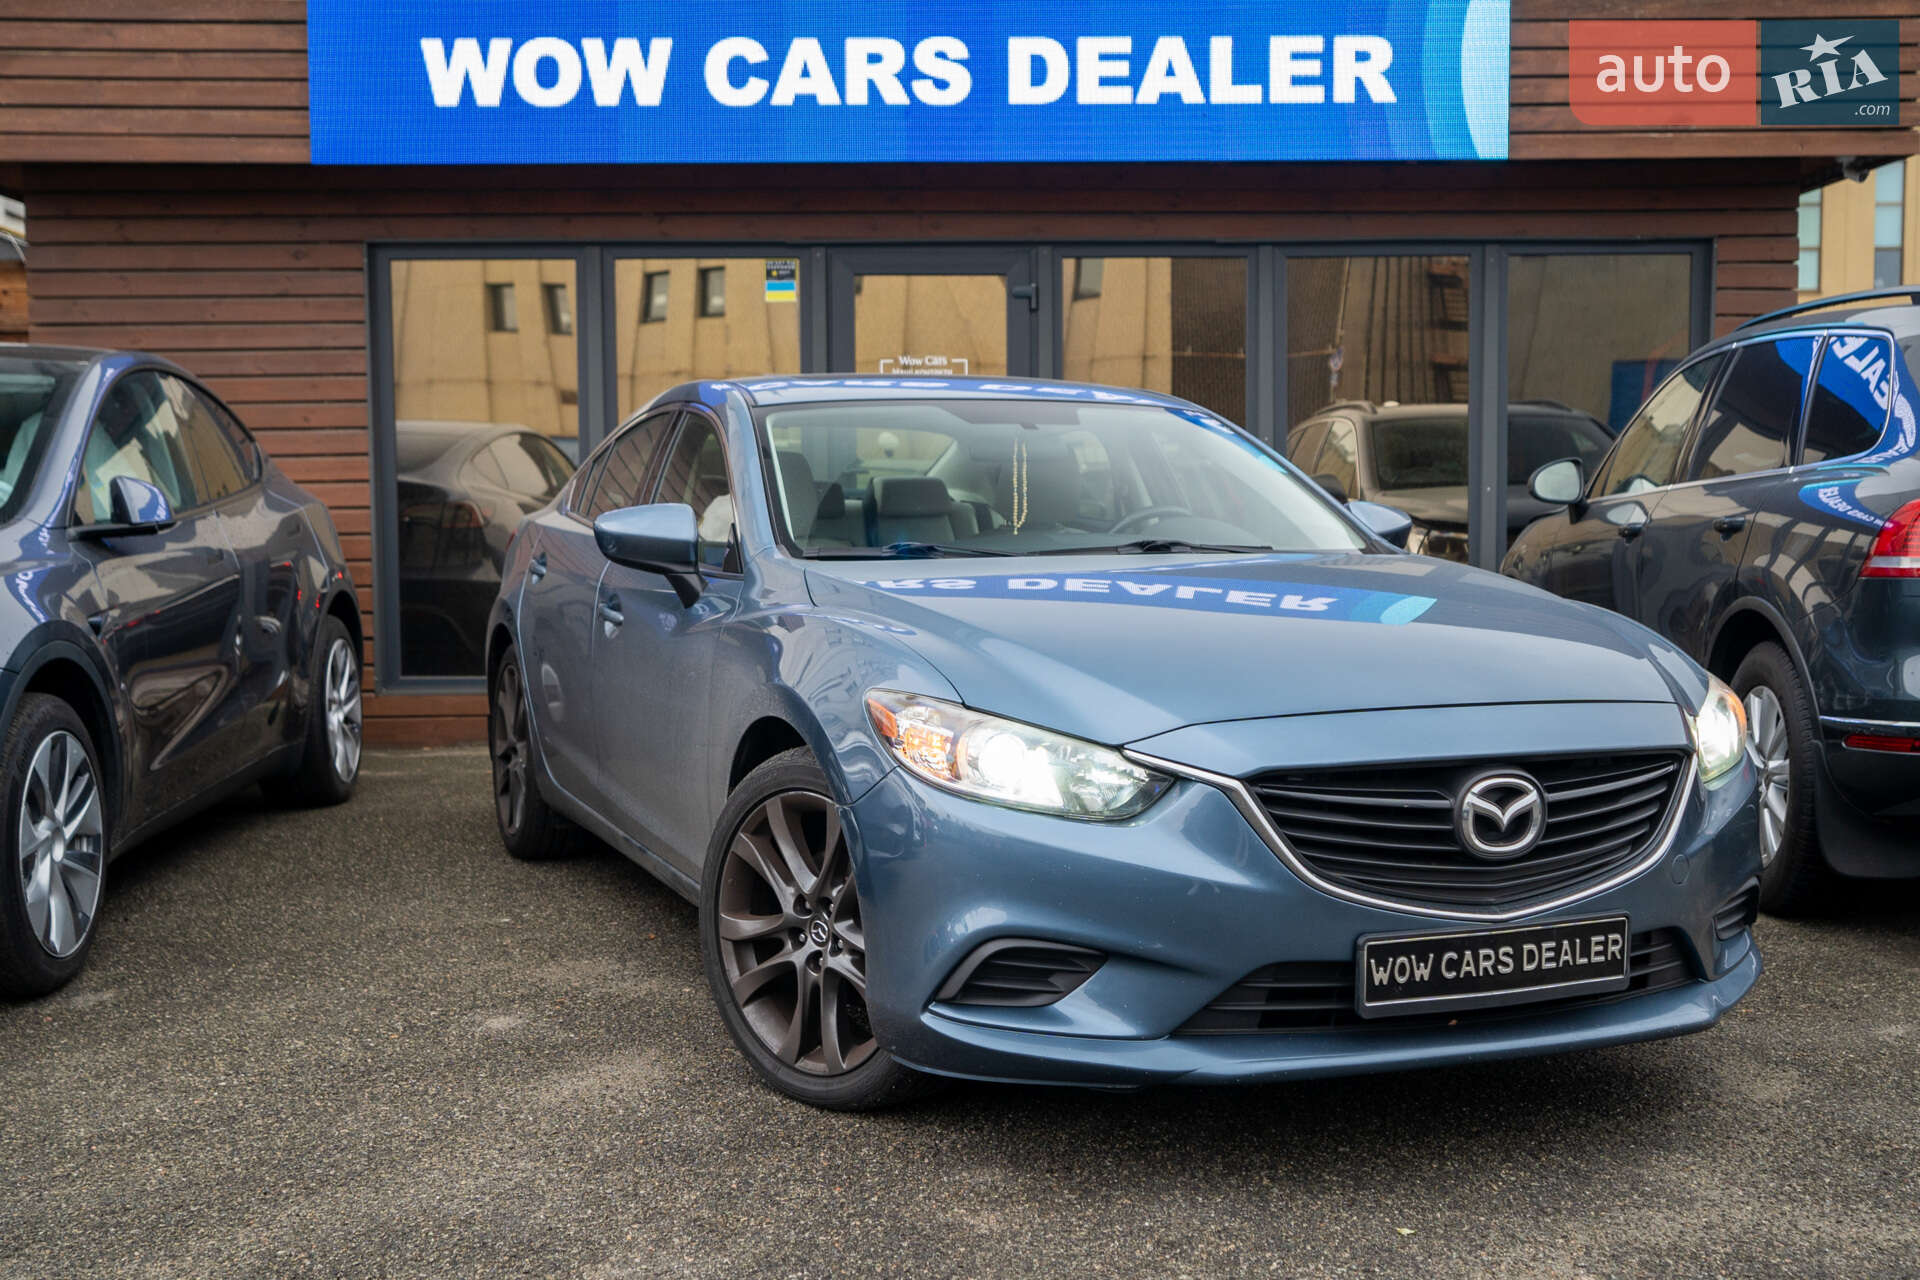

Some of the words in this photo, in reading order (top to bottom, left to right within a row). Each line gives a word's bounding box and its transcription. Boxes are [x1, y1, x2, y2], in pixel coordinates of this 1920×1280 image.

[420, 37, 673, 108] WOW
[704, 36, 972, 107] CARS
[1007, 35, 1398, 105] DEALER
[898, 355, 923, 366] Wow
[1369, 953, 1435, 987] WOW
[1440, 945, 1515, 980] CARS
[1522, 933, 1624, 972] DEALER
